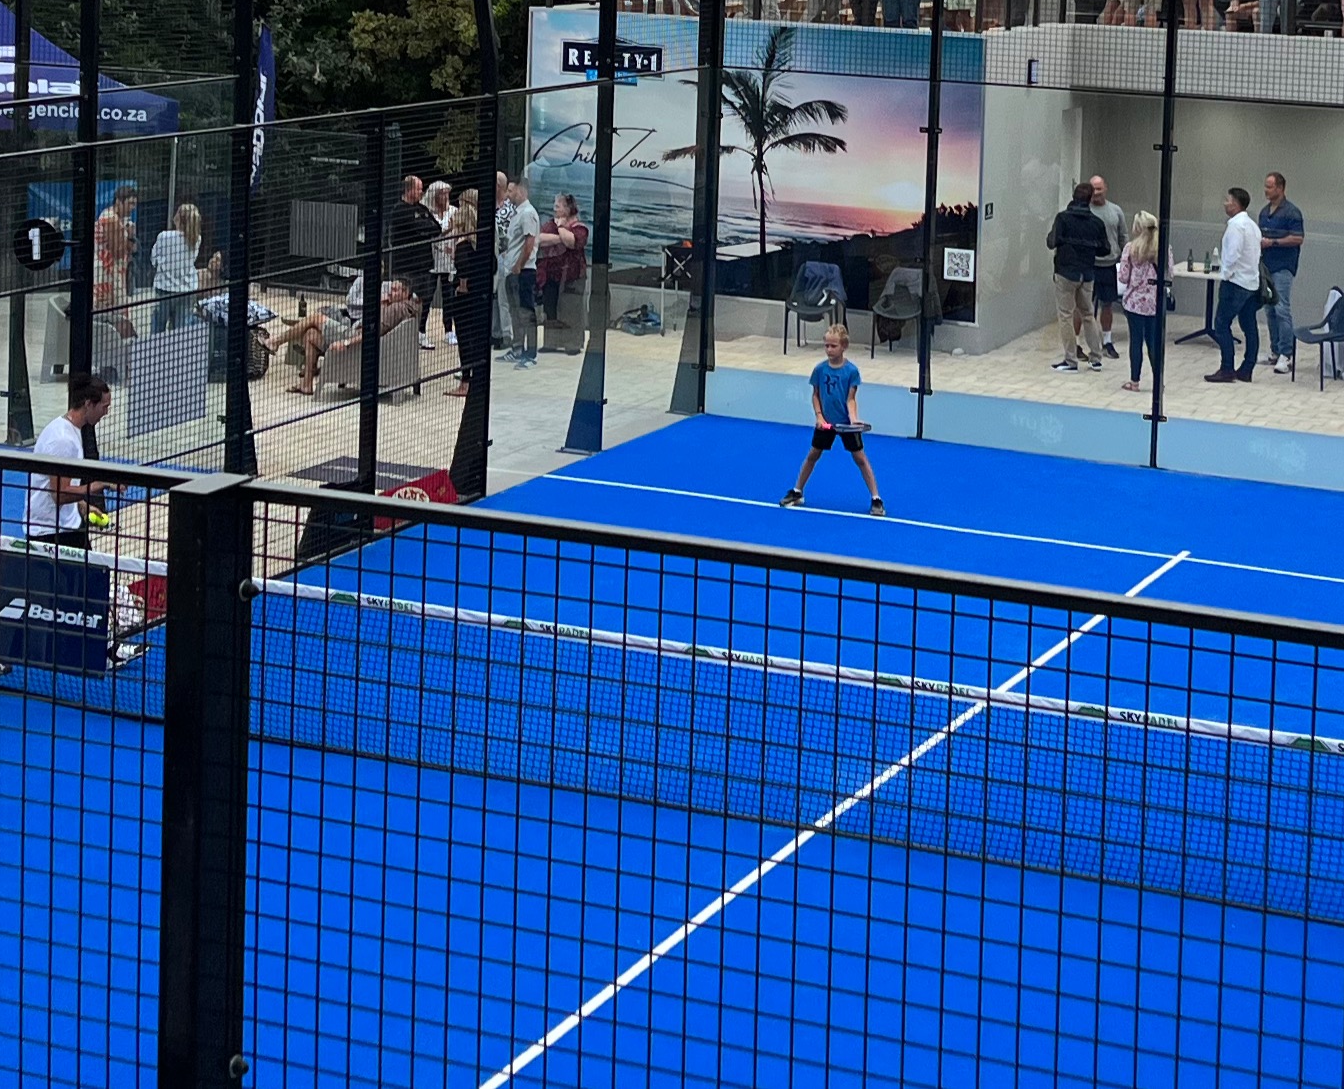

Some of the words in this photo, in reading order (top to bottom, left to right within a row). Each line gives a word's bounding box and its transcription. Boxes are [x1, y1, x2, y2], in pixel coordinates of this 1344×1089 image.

[28, 227, 41, 260] 1
[27, 603, 103, 629] Babolat
[721, 651, 774, 666] SYPADL
